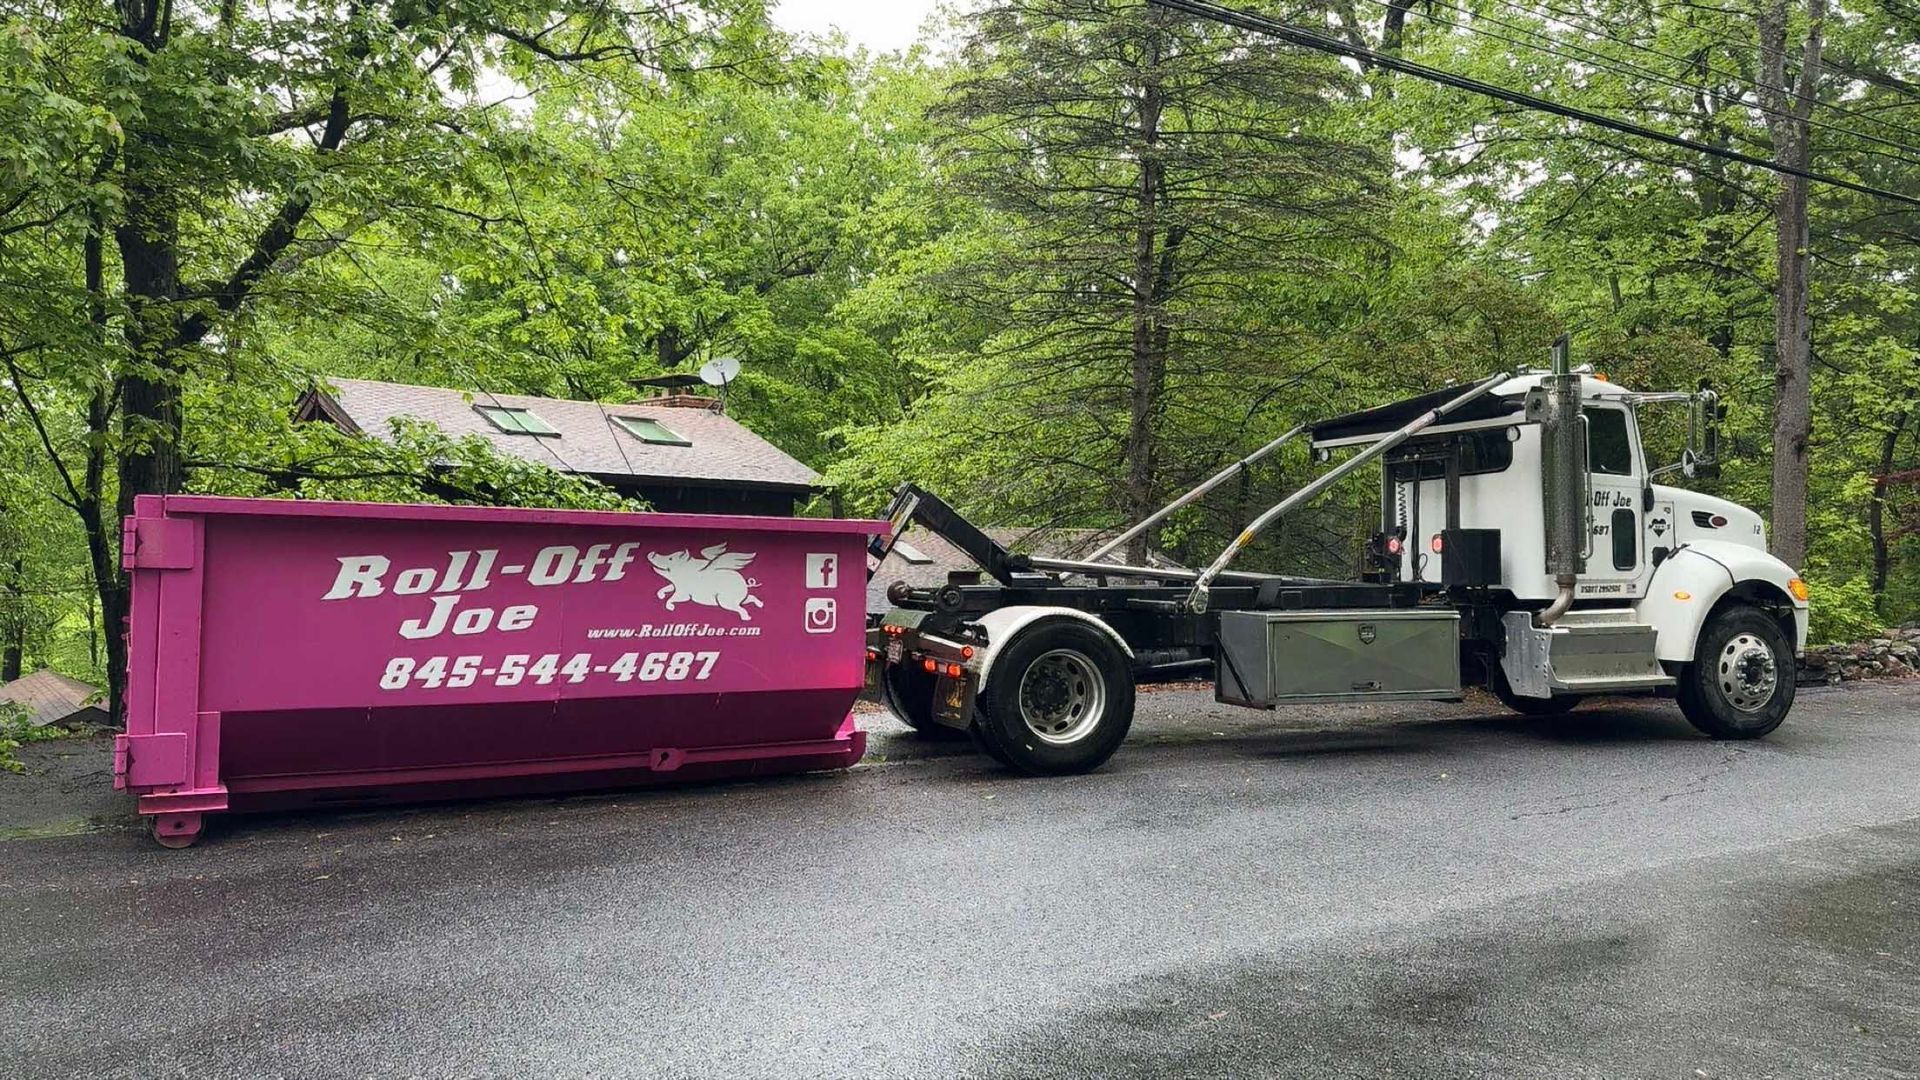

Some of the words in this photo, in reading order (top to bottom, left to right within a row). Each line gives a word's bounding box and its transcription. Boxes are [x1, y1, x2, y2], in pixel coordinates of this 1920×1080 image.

[1613, 491, 1632, 507] Joe
[320, 542, 641, 600] Roll-Off
[398, 595, 539, 640] Joe
[587, 623, 762, 640] www.RollOffJoe.com
[379, 651, 720, 690] 845-544-4687
